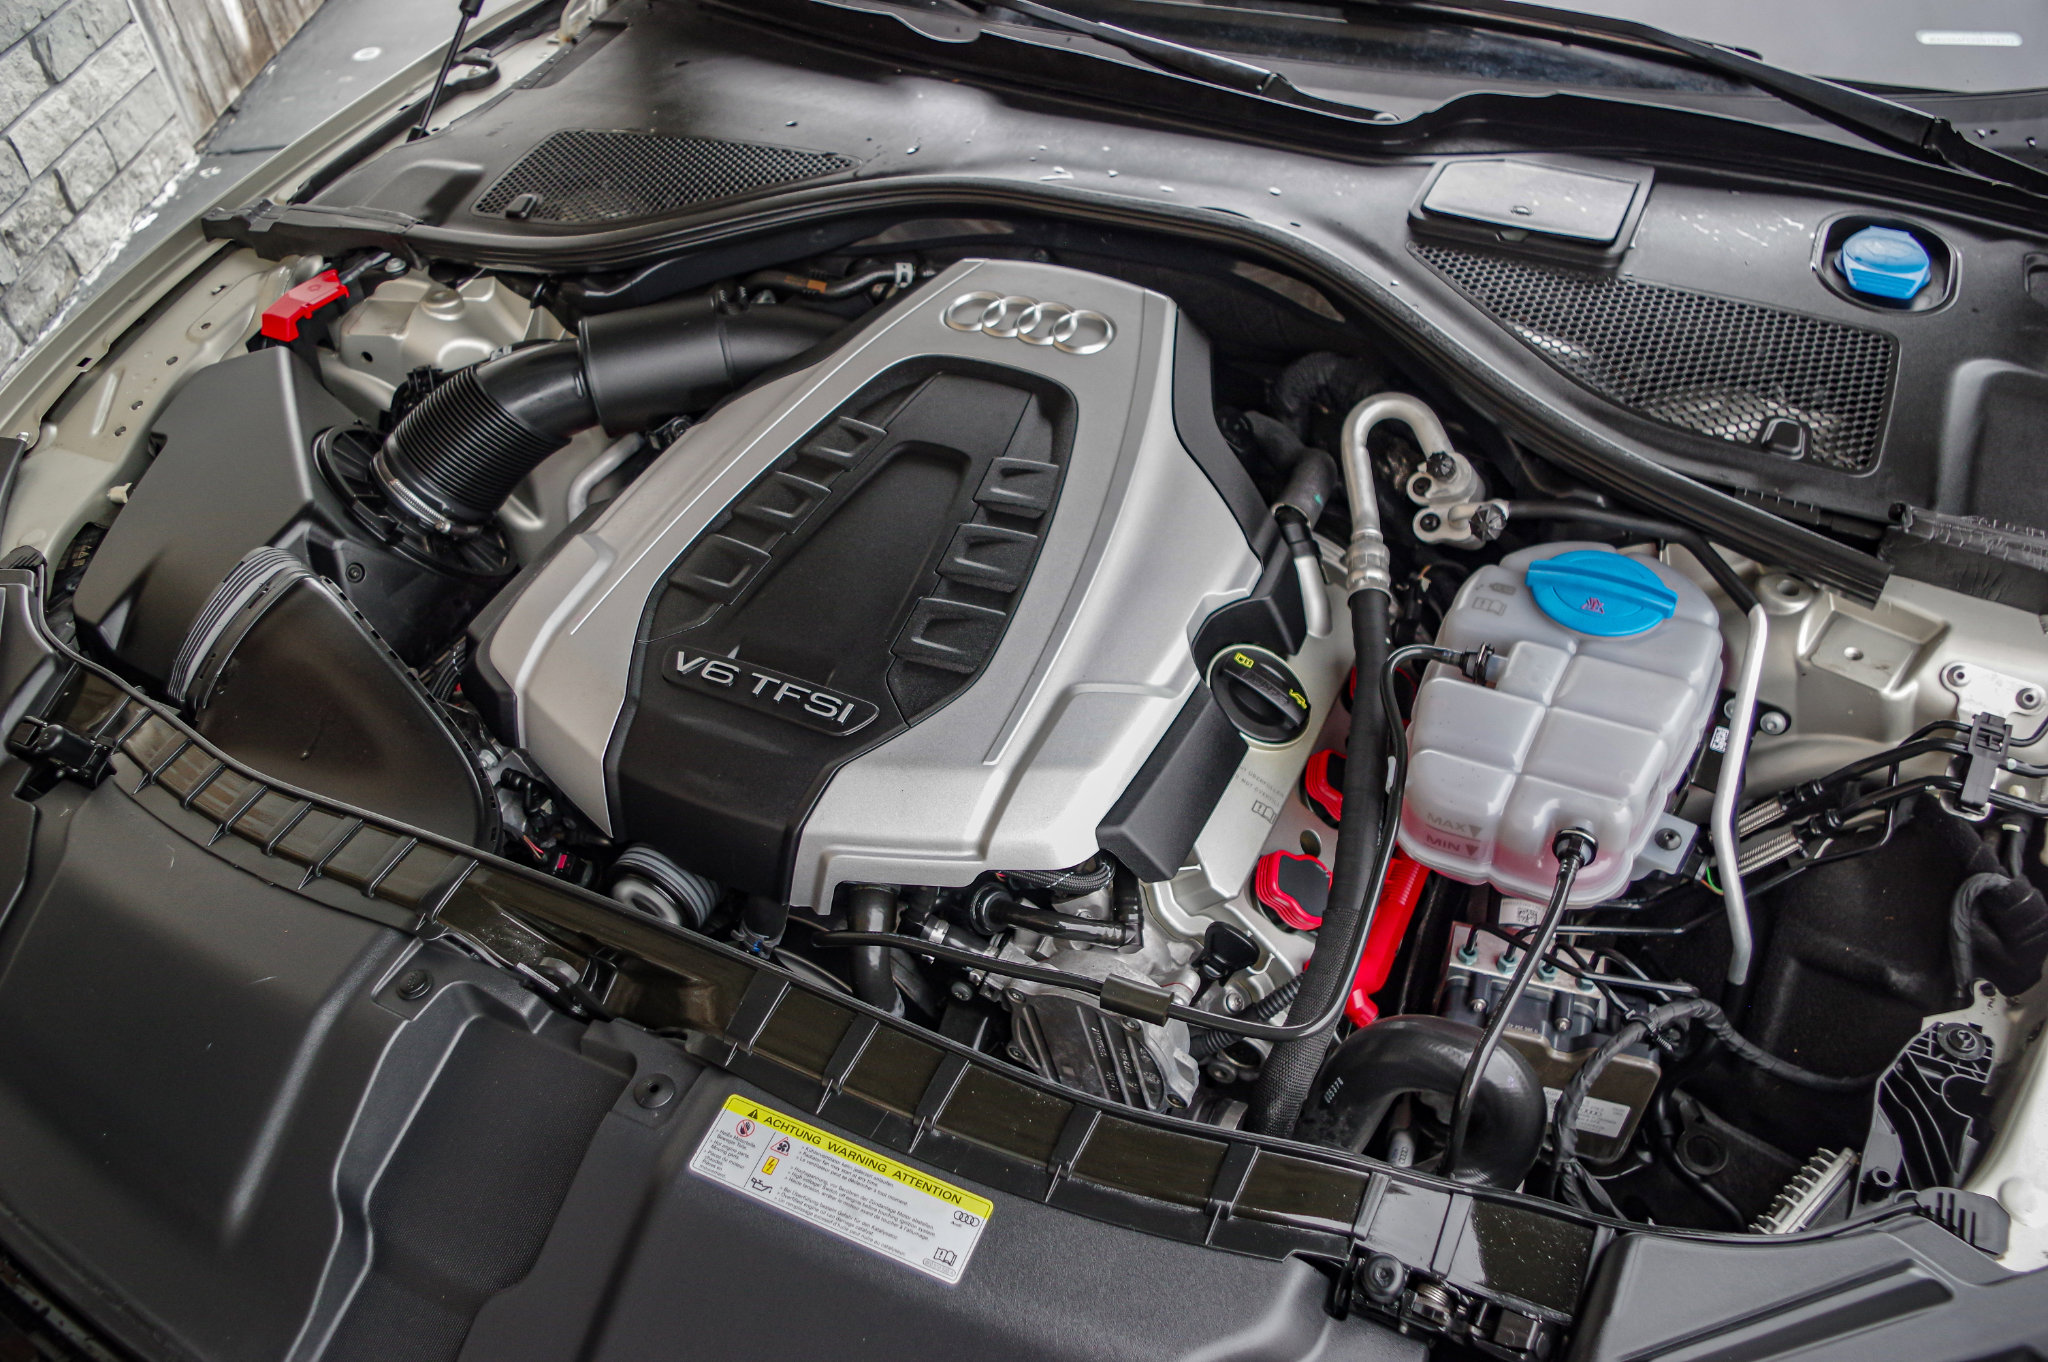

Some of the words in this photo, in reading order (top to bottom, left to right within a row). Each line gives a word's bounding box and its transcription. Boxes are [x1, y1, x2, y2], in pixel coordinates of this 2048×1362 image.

[676, 651, 740, 687] V6
[752, 672, 855, 726] TFSI
[1426, 811, 1466, 832] MAX
[1426, 833, 1461, 851] MIN
[764, 1116, 821, 1145] ACHTUNG
[828, 1142, 887, 1173] WARNING
[893, 1171, 962, 1204] ATTENTION
